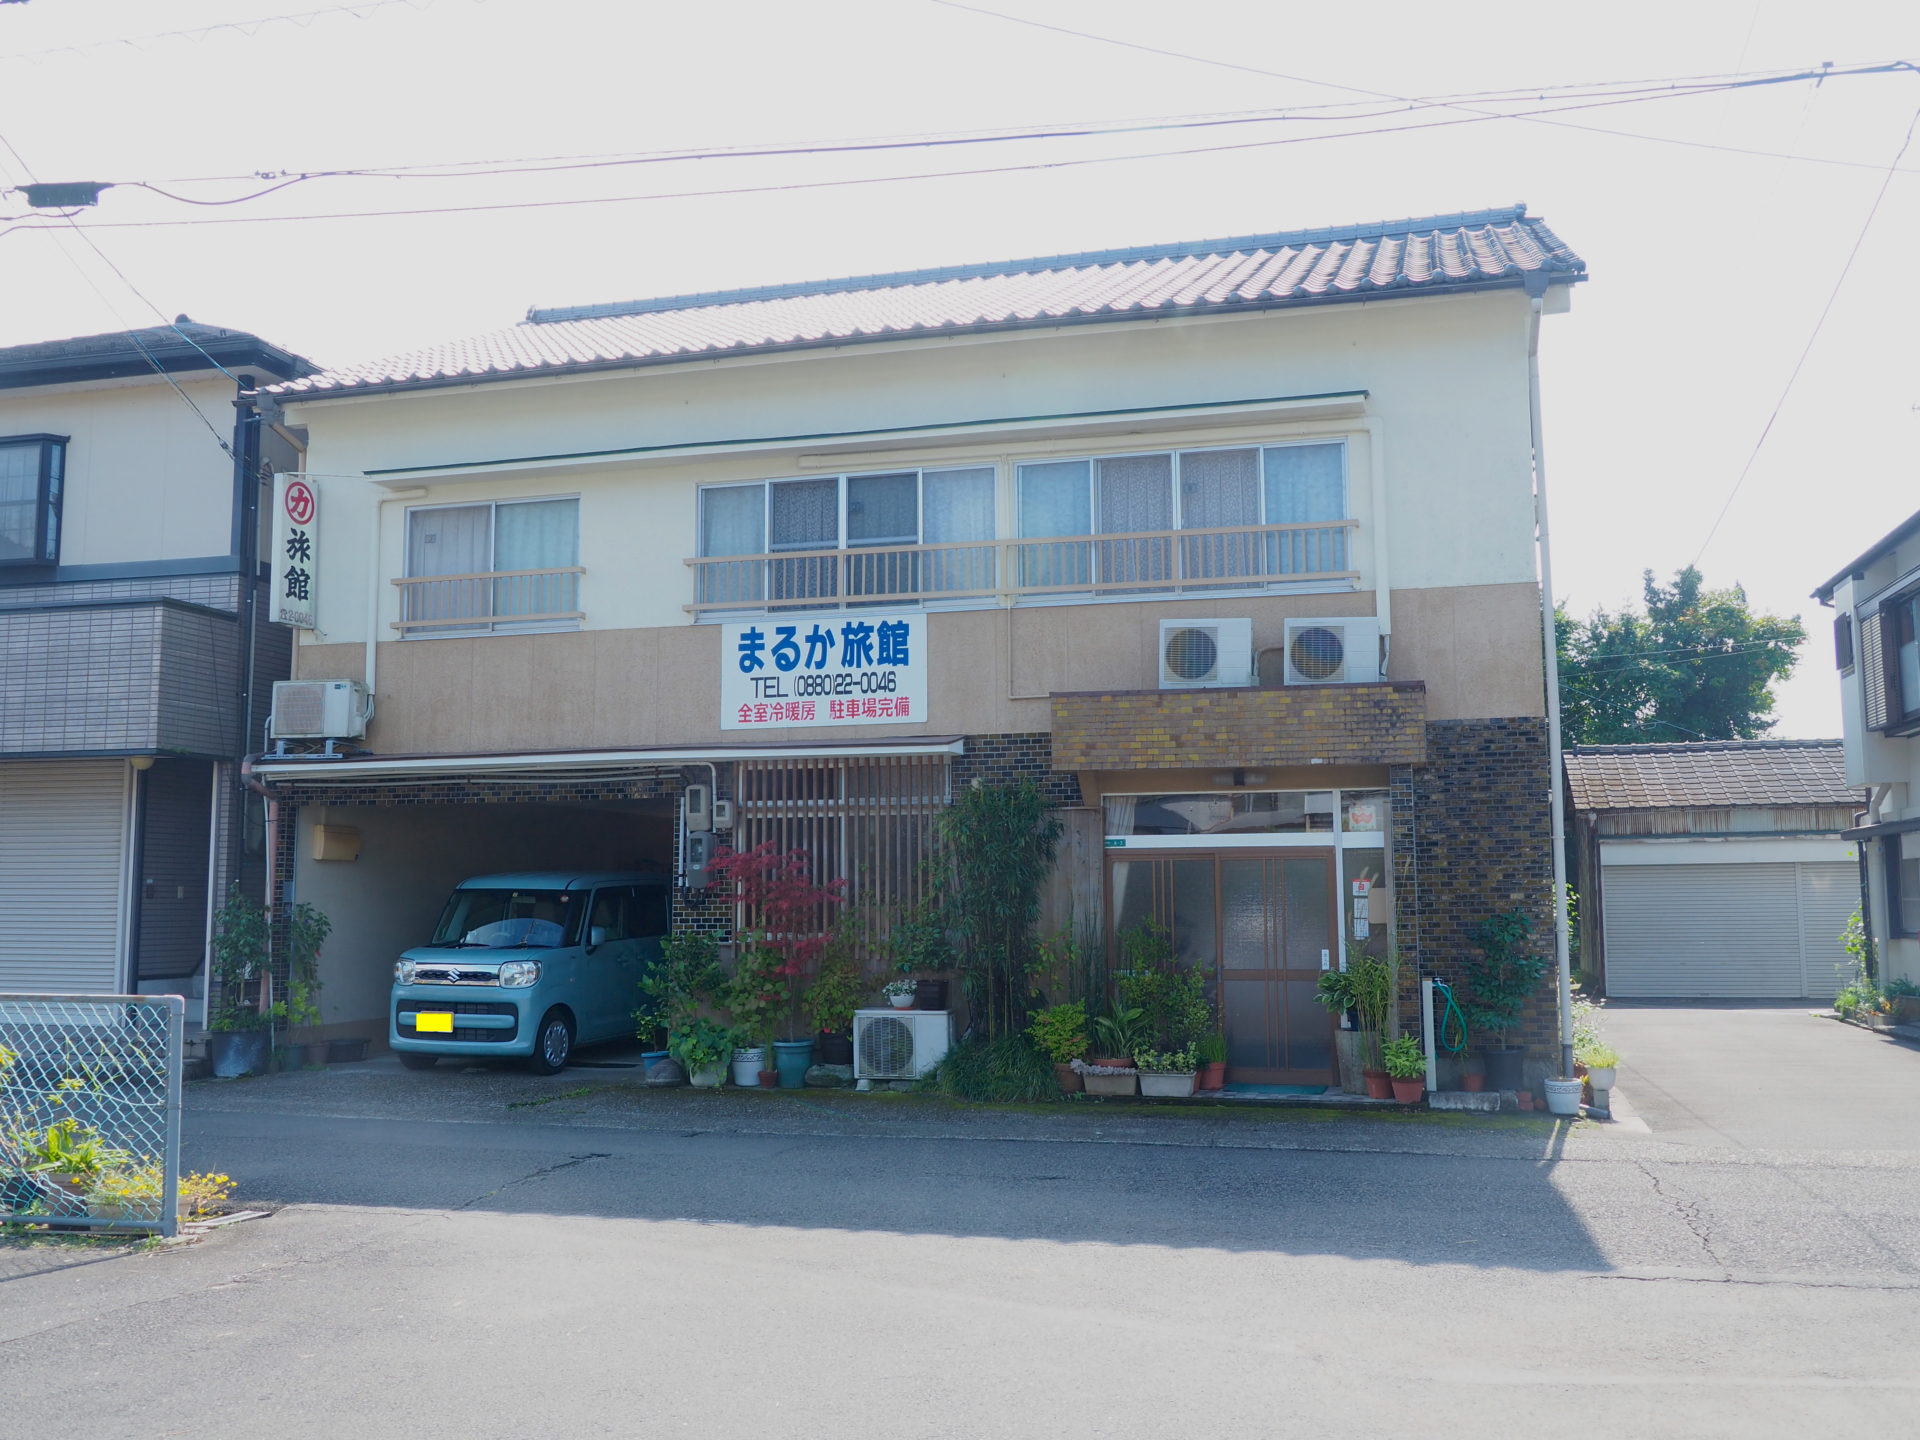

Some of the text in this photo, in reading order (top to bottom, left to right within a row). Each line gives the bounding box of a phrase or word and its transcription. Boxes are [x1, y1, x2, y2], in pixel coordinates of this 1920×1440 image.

[284, 528, 311, 601] 旅館
[738, 620, 909, 673] まるか旅館
[750, 671, 896, 698] TEL (0880)22-0046
[738, 697, 910, 723] 全室冷暖房 駐車場完備
